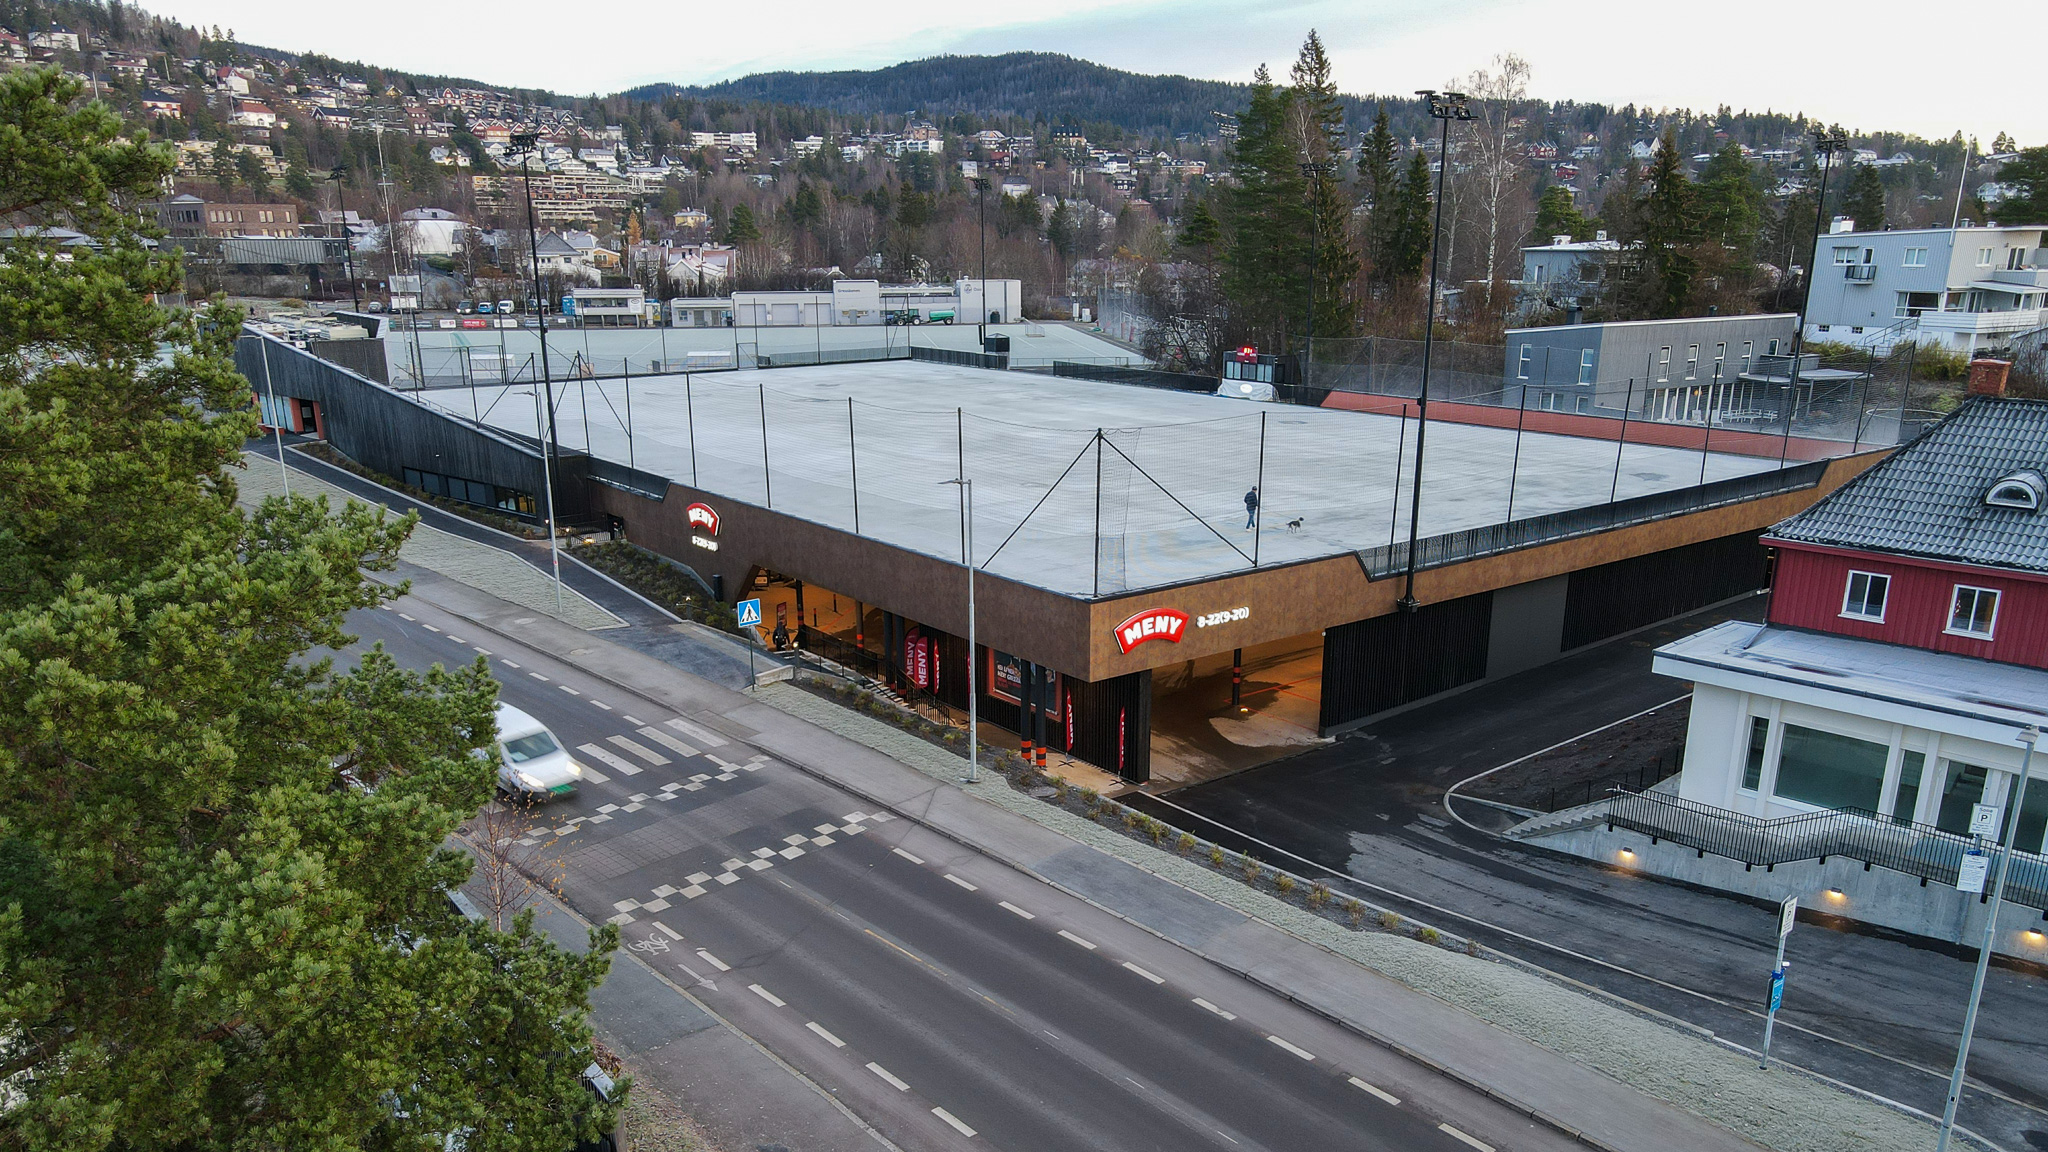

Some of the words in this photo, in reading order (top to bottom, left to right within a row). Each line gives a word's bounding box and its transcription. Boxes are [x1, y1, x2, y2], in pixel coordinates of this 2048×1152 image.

[1123, 615, 1182, 645] MENY
[1197, 606, 1250, 628] 8-22(9-20)
[906, 642, 915, 675] MENY
[917, 649, 928, 685] MENY
[1980, 814, 1988, 822] P
